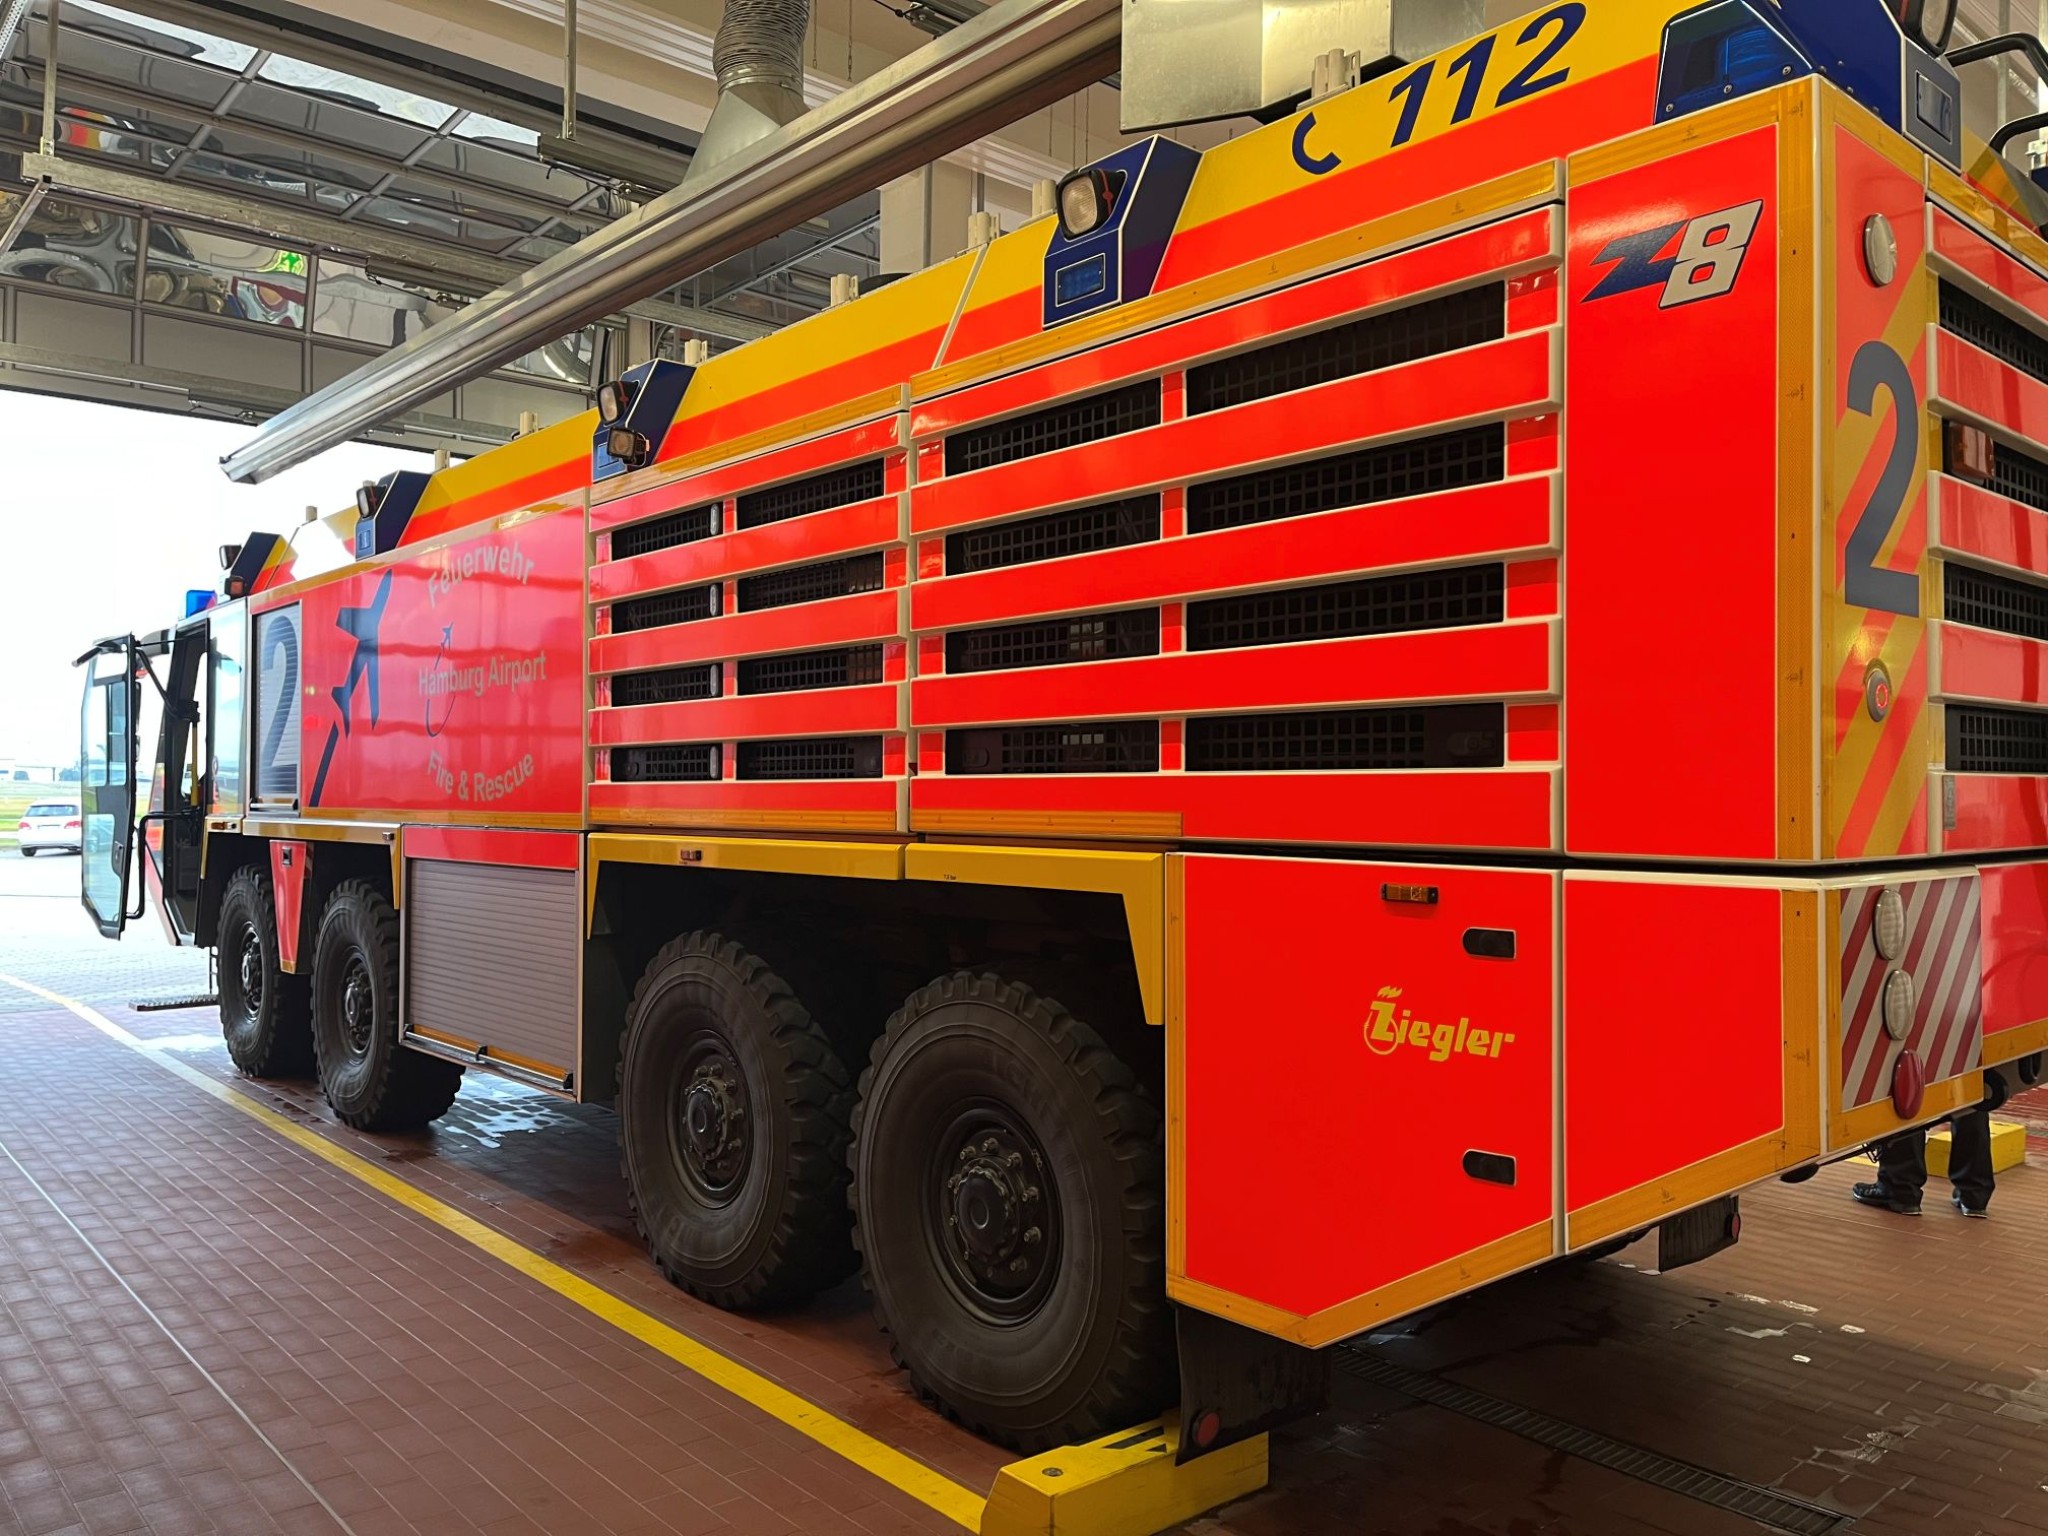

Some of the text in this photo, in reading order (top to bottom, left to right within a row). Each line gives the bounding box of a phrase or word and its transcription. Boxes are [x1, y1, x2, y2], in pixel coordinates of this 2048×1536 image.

[1388, 2, 1586, 148] 112
[1844, 340, 1919, 618] 2
[428, 541, 535, 609] Feuerwehr
[260, 615, 298, 794] 2
[418, 650, 547, 697] Hamburg Airport
[427, 747, 534, 803] Fire & Rescue
[1367, 996, 1516, 1063] Ziegler
